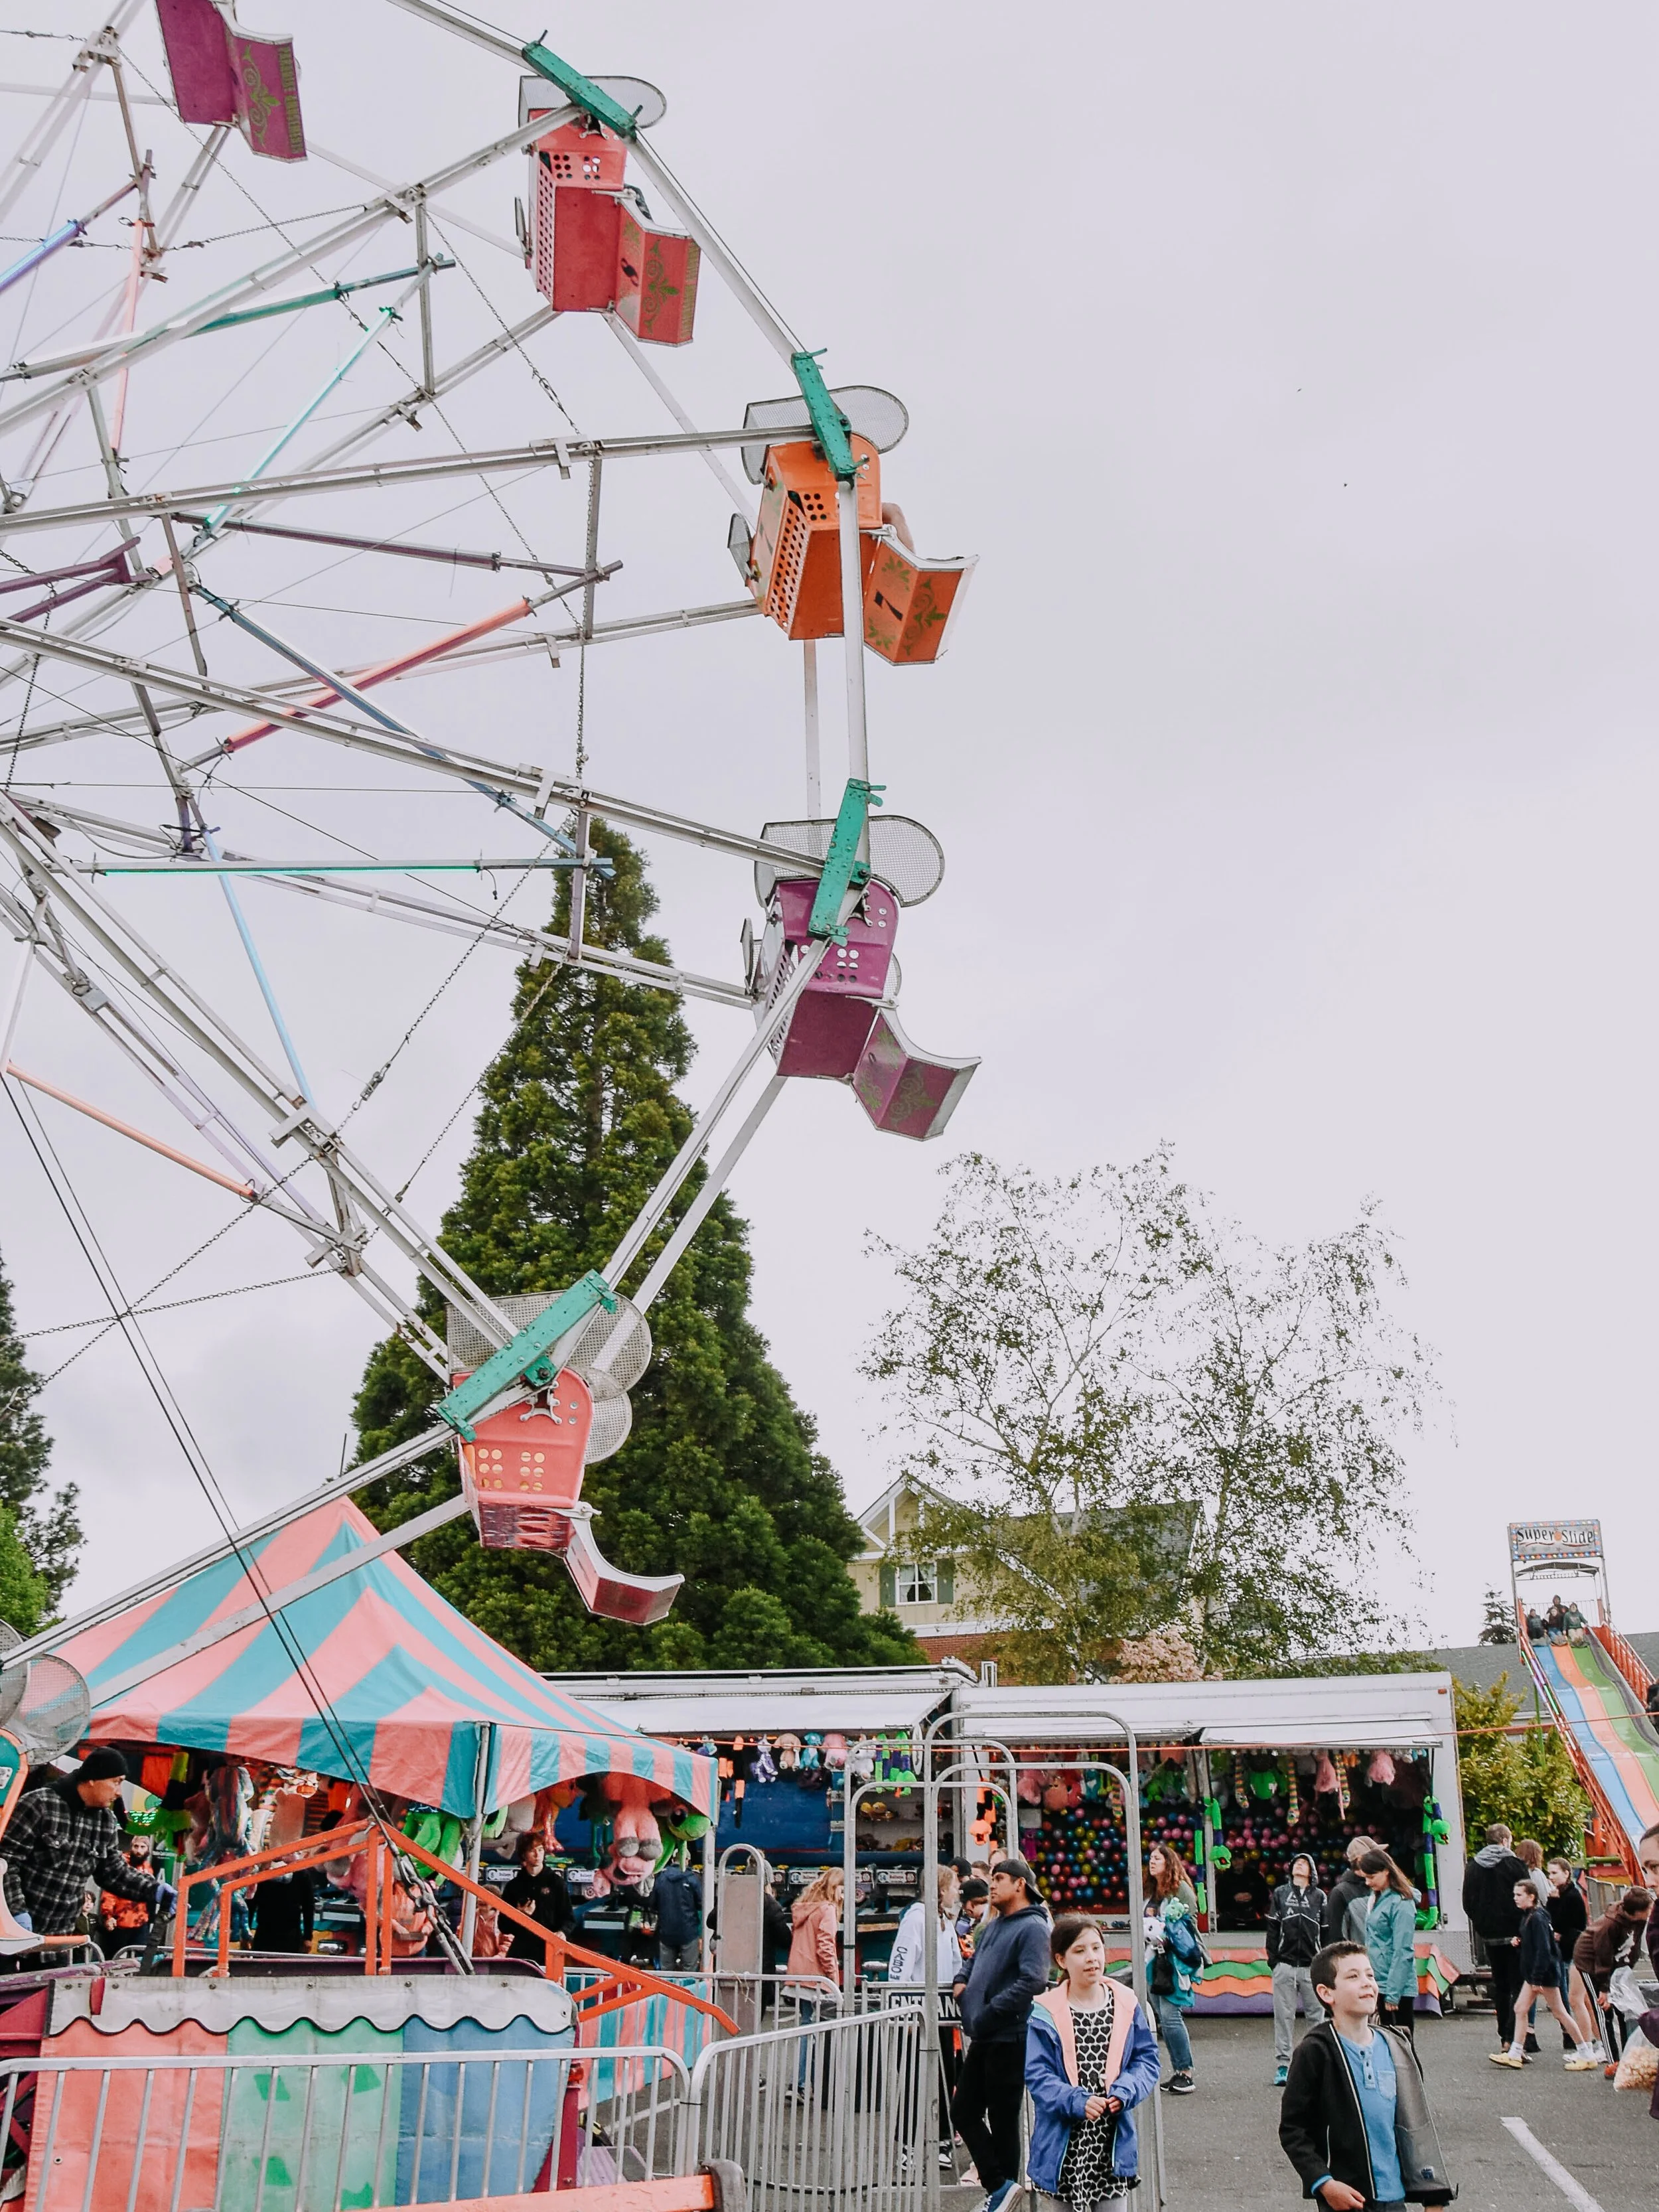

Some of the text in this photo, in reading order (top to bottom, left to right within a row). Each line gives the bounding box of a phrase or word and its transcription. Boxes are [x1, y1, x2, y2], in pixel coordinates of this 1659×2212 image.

[874, 589, 903, 621] 7
[1517, 1528, 1594, 1544] Super Slide
[891, 1995, 962, 2018] ENTAN
